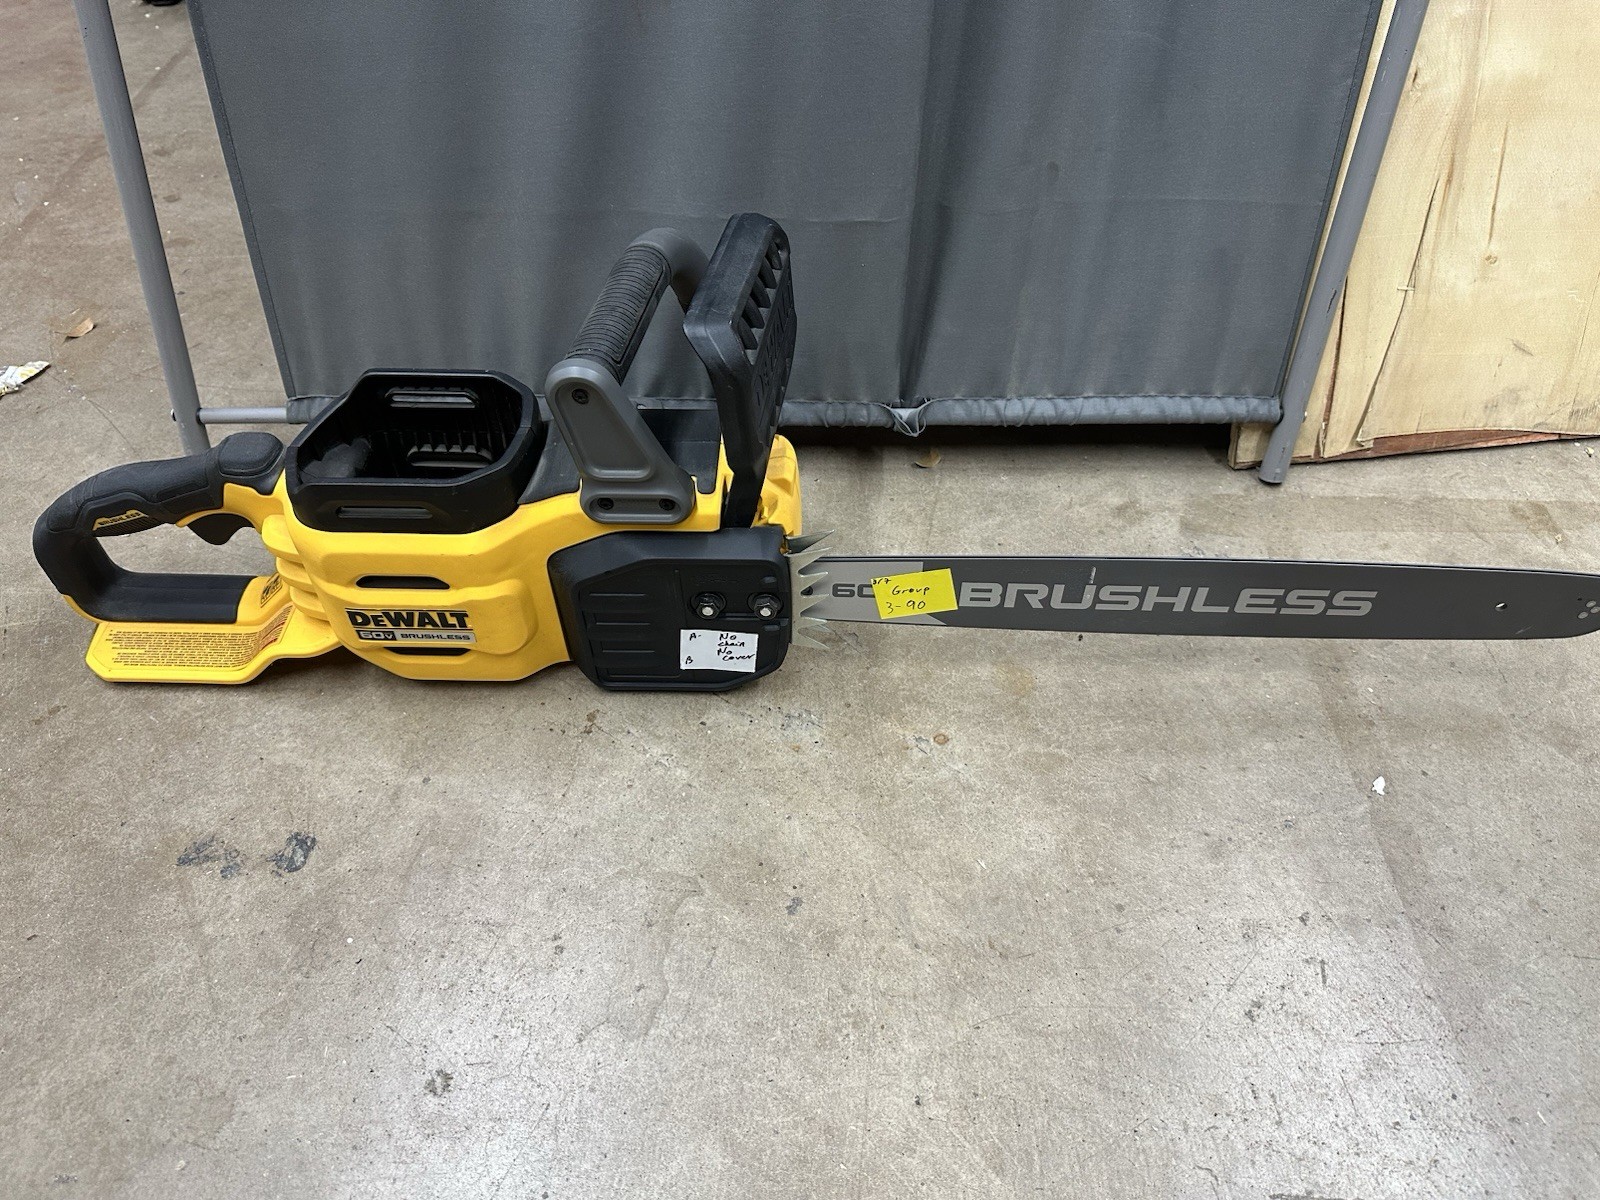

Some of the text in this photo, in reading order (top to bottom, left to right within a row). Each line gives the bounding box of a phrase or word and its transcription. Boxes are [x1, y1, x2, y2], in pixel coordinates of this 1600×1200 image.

[891, 585, 930, 595] Group
[958, 581, 1378, 616] BRUSHLESS
[400, 633, 471, 641] BRUSHLESS
